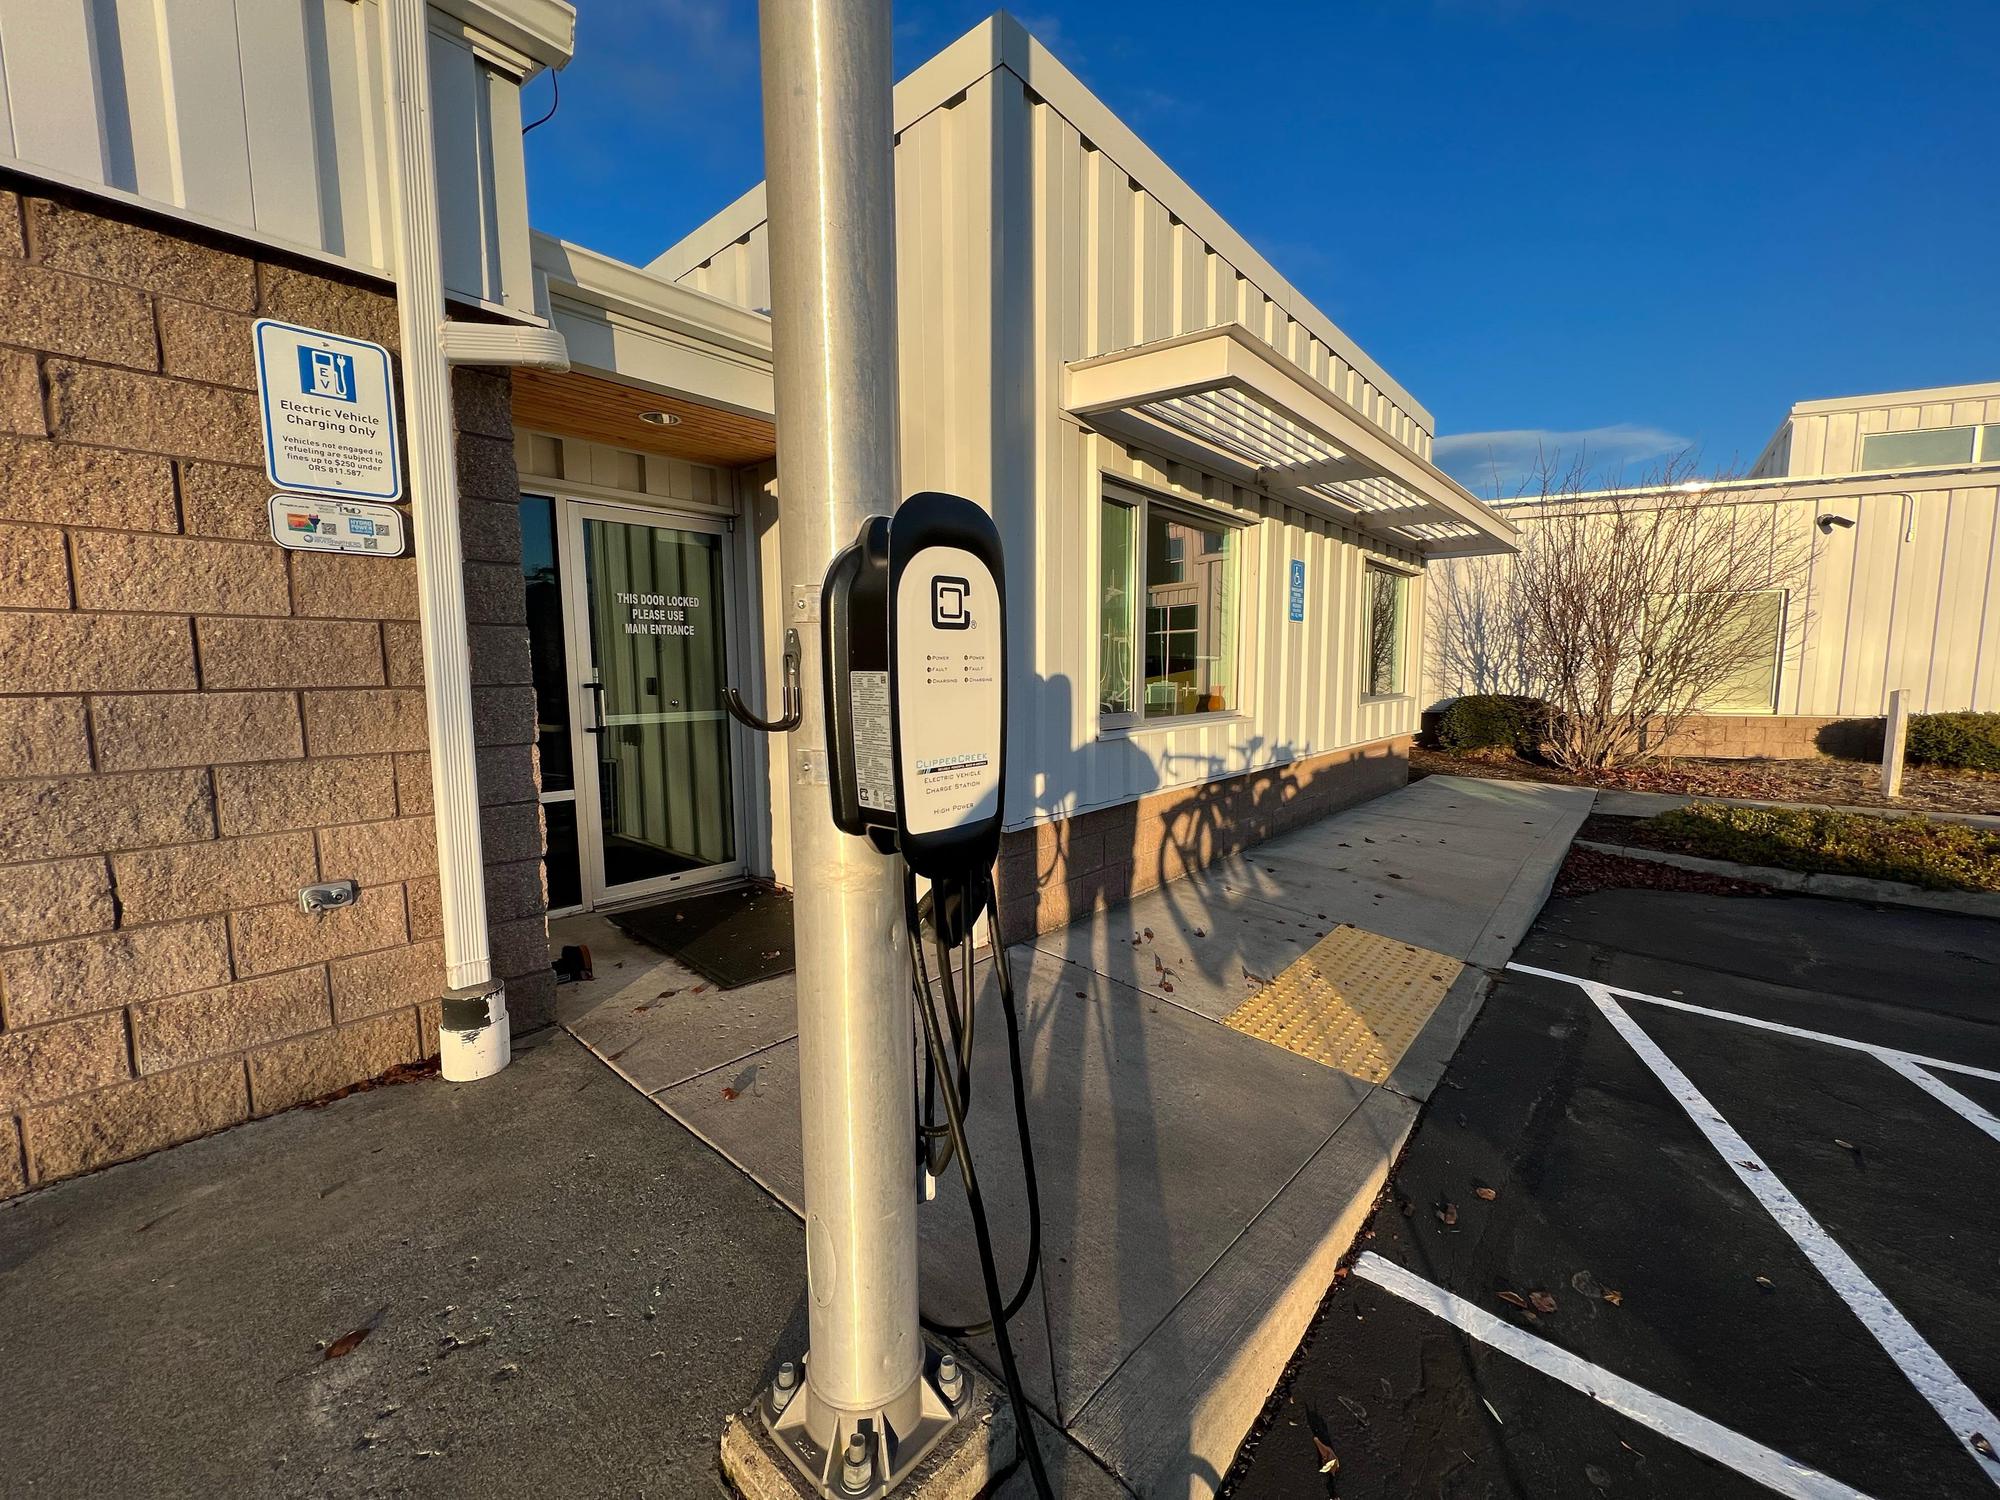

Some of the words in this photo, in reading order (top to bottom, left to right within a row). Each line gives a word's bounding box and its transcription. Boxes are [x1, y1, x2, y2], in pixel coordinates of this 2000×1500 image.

[280, 399, 332, 417] Electric
[334, 408, 379, 425] Vehicle
[286, 414, 345, 434] Charging
[349, 424, 376, 438] Only
[282, 435, 320, 447] Vehicles
[338, 445, 373, 455] engaged
[284, 444, 325, 457] refueling
[343, 453, 373, 462] subject
[286, 453, 309, 462] fines
[335, 459, 355, 468] $250
[357, 463, 382, 471] under
[308, 463, 327, 472] ORS
[328, 466, 364, 477] 811.587.
[617, 592, 638, 604] THIS
[640, 594, 665, 606] DOOR
[667, 596, 699, 607] LOCKED
[632, 608, 665, 620] PLEASE
[667, 610, 684, 621] USE
[625, 623, 648, 634] MAIN
[650, 624, 695, 635] ENTRANCE
[924, 774, 954, 784] ELECTRIC
[955, 770, 981, 779] VEHICLE
[926, 784, 953, 795] CHARGE
[954, 781, 981, 790] STATION
[933, 807, 950, 815] HIGH
[952, 802, 974, 811] POWER
